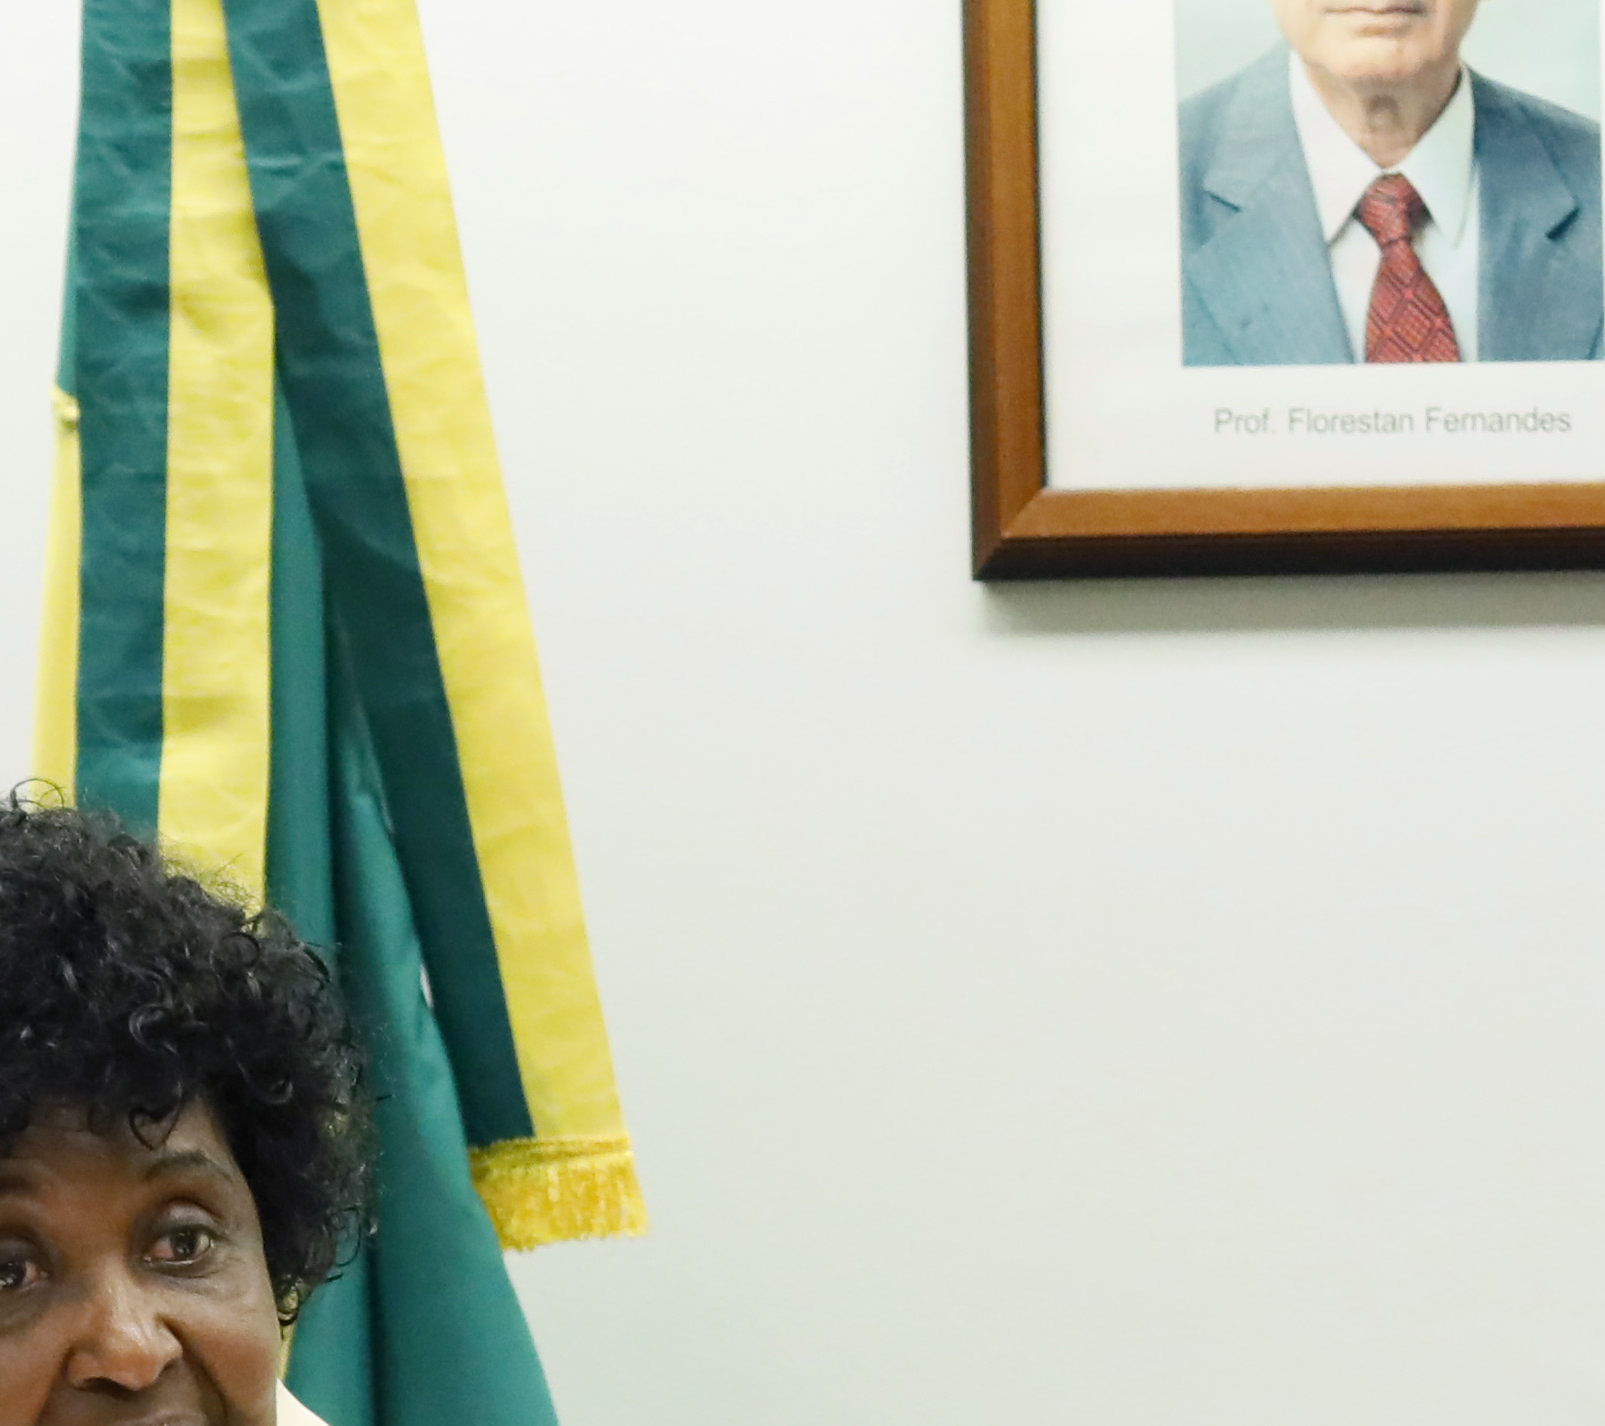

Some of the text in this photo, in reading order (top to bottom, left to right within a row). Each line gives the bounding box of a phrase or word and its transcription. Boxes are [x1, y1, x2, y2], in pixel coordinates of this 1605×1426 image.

[1214, 406, 1572, 433] Prof. Florestan Fernandes
